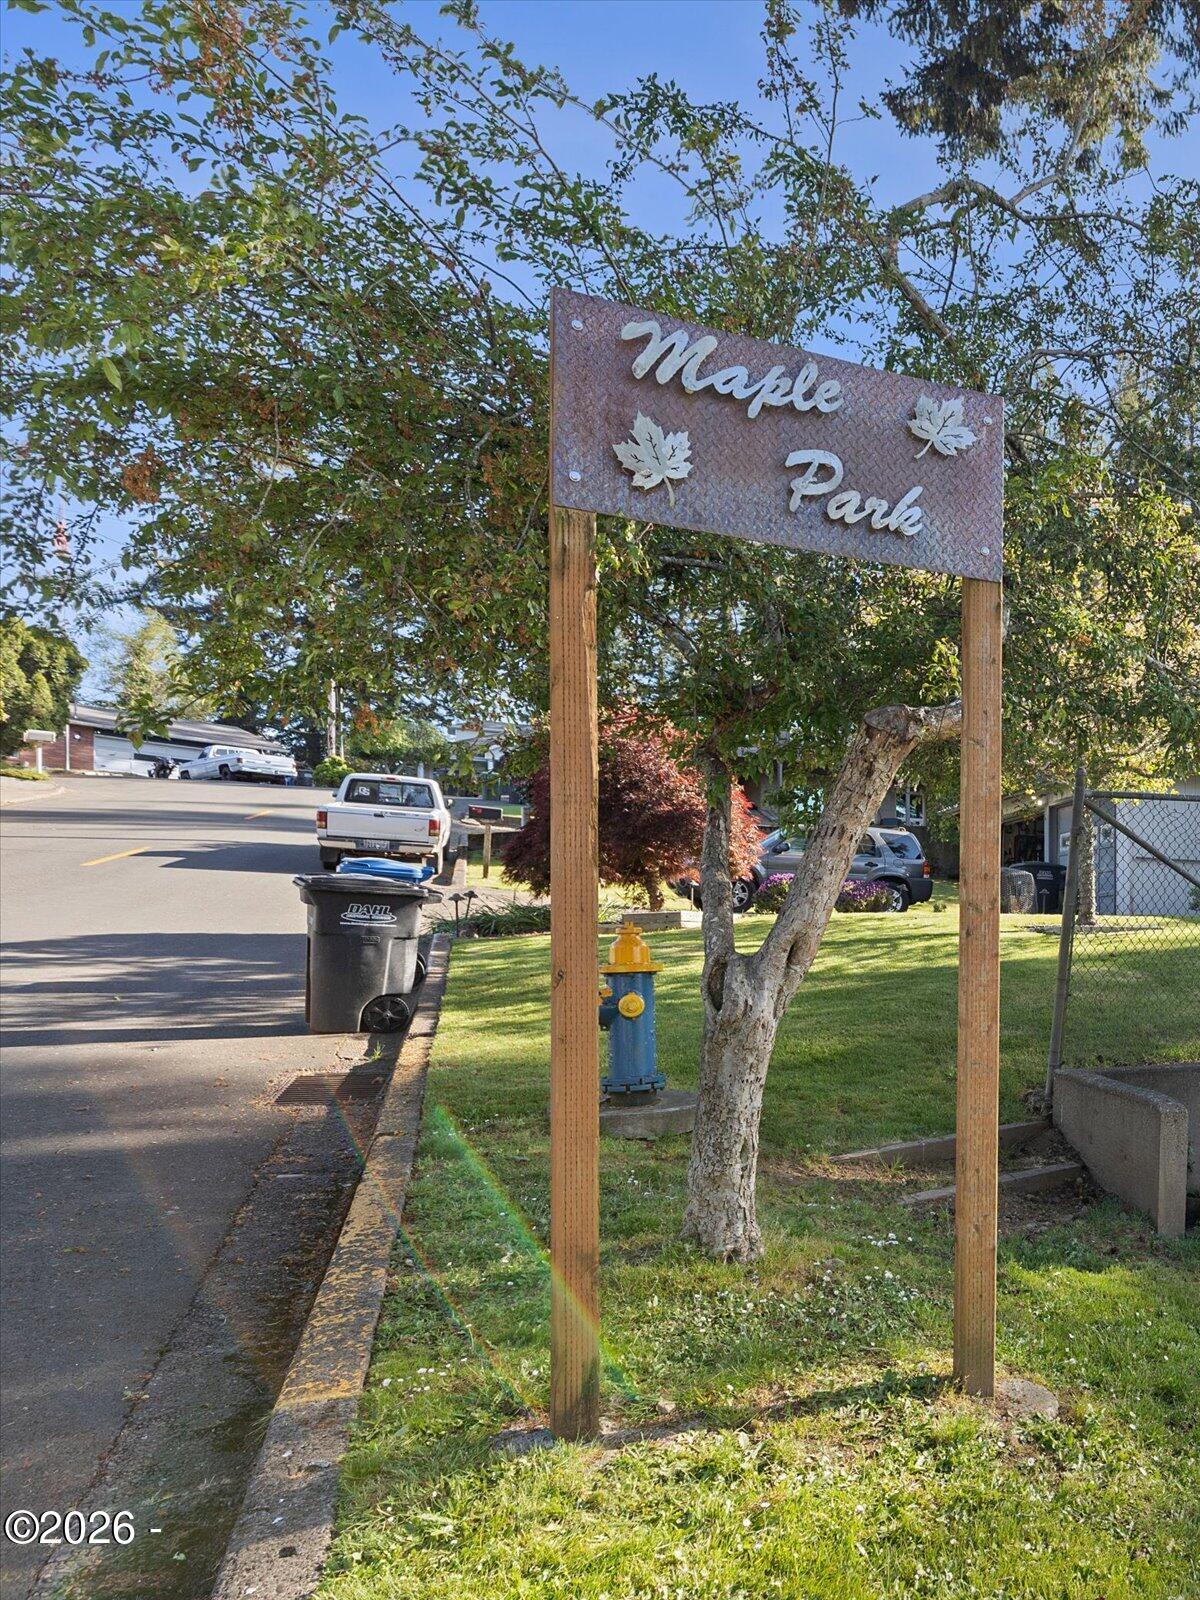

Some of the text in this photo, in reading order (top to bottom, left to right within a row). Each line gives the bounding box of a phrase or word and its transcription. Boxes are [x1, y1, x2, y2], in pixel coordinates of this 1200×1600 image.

[620, 319, 844, 419] Maple
[784, 448, 923, 536] Park
[347, 903, 392, 915] DAHL
